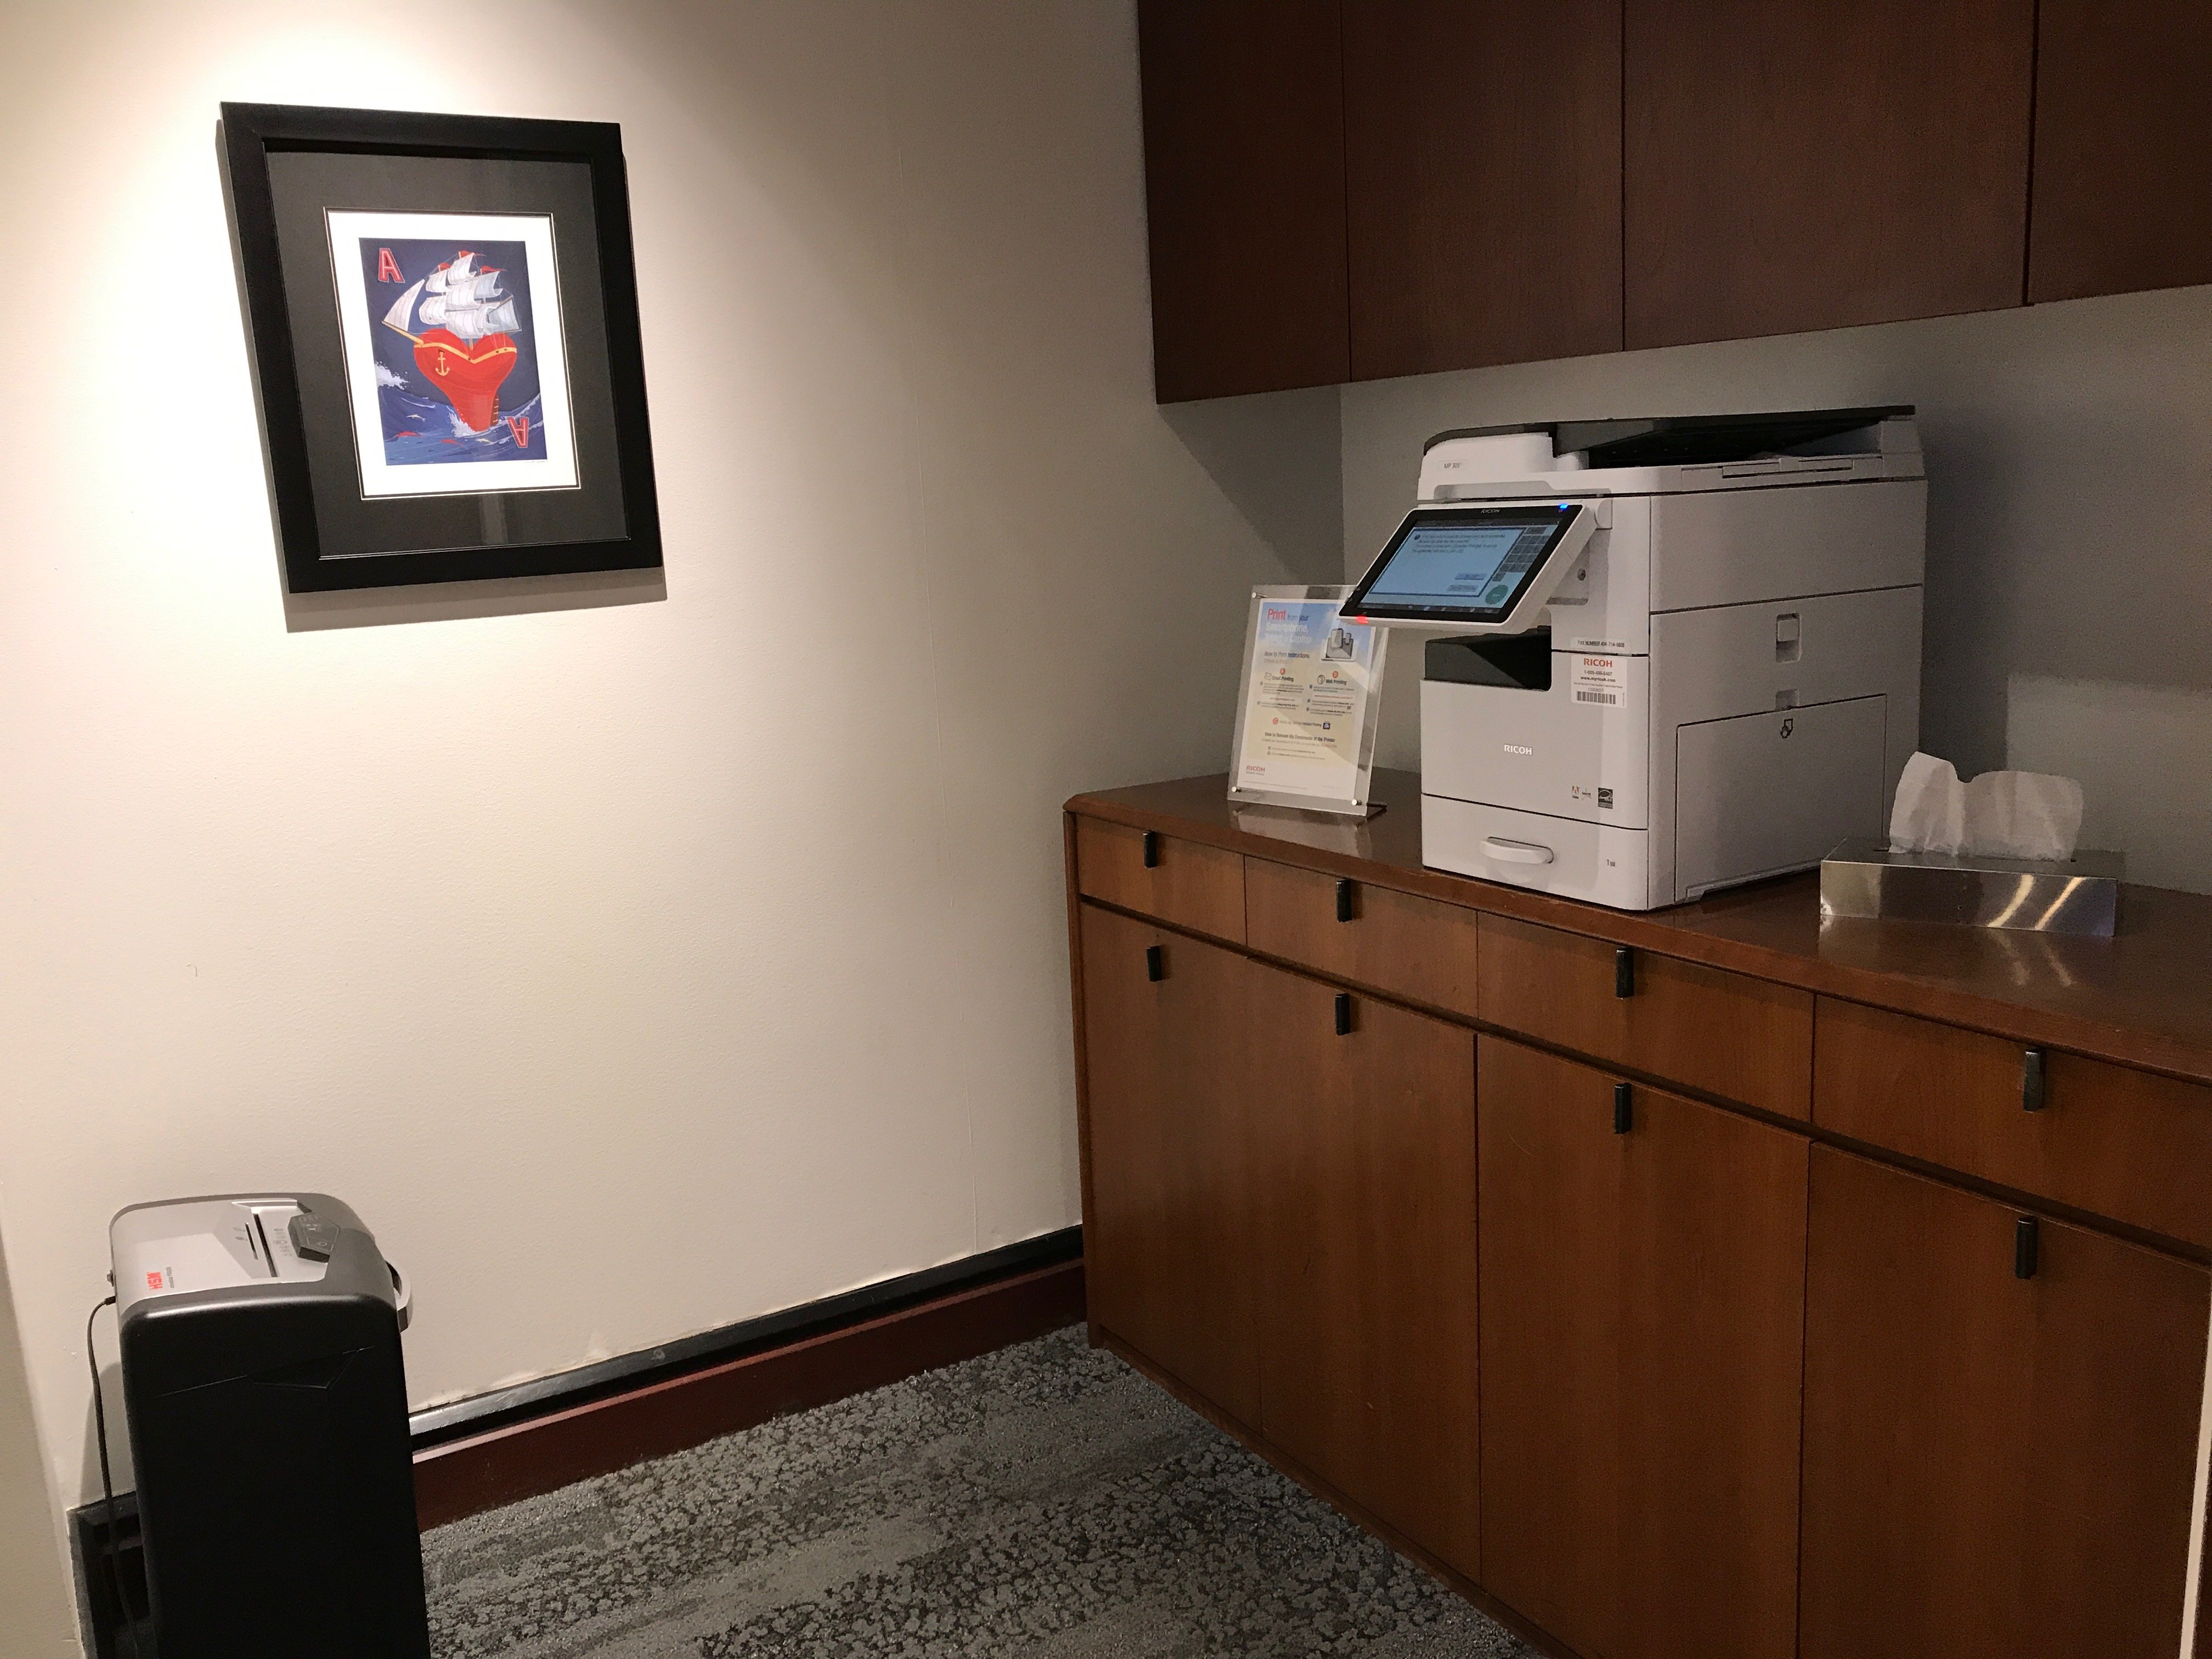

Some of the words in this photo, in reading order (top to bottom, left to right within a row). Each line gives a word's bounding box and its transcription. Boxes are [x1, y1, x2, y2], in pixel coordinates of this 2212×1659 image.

[378, 247, 405, 283] A
[1267, 608, 1286, 620] Print
[1583, 658, 1612, 668] RICOH
[1504, 744, 1533, 755] RICOH
[146, 1272, 163, 1290] HSM
